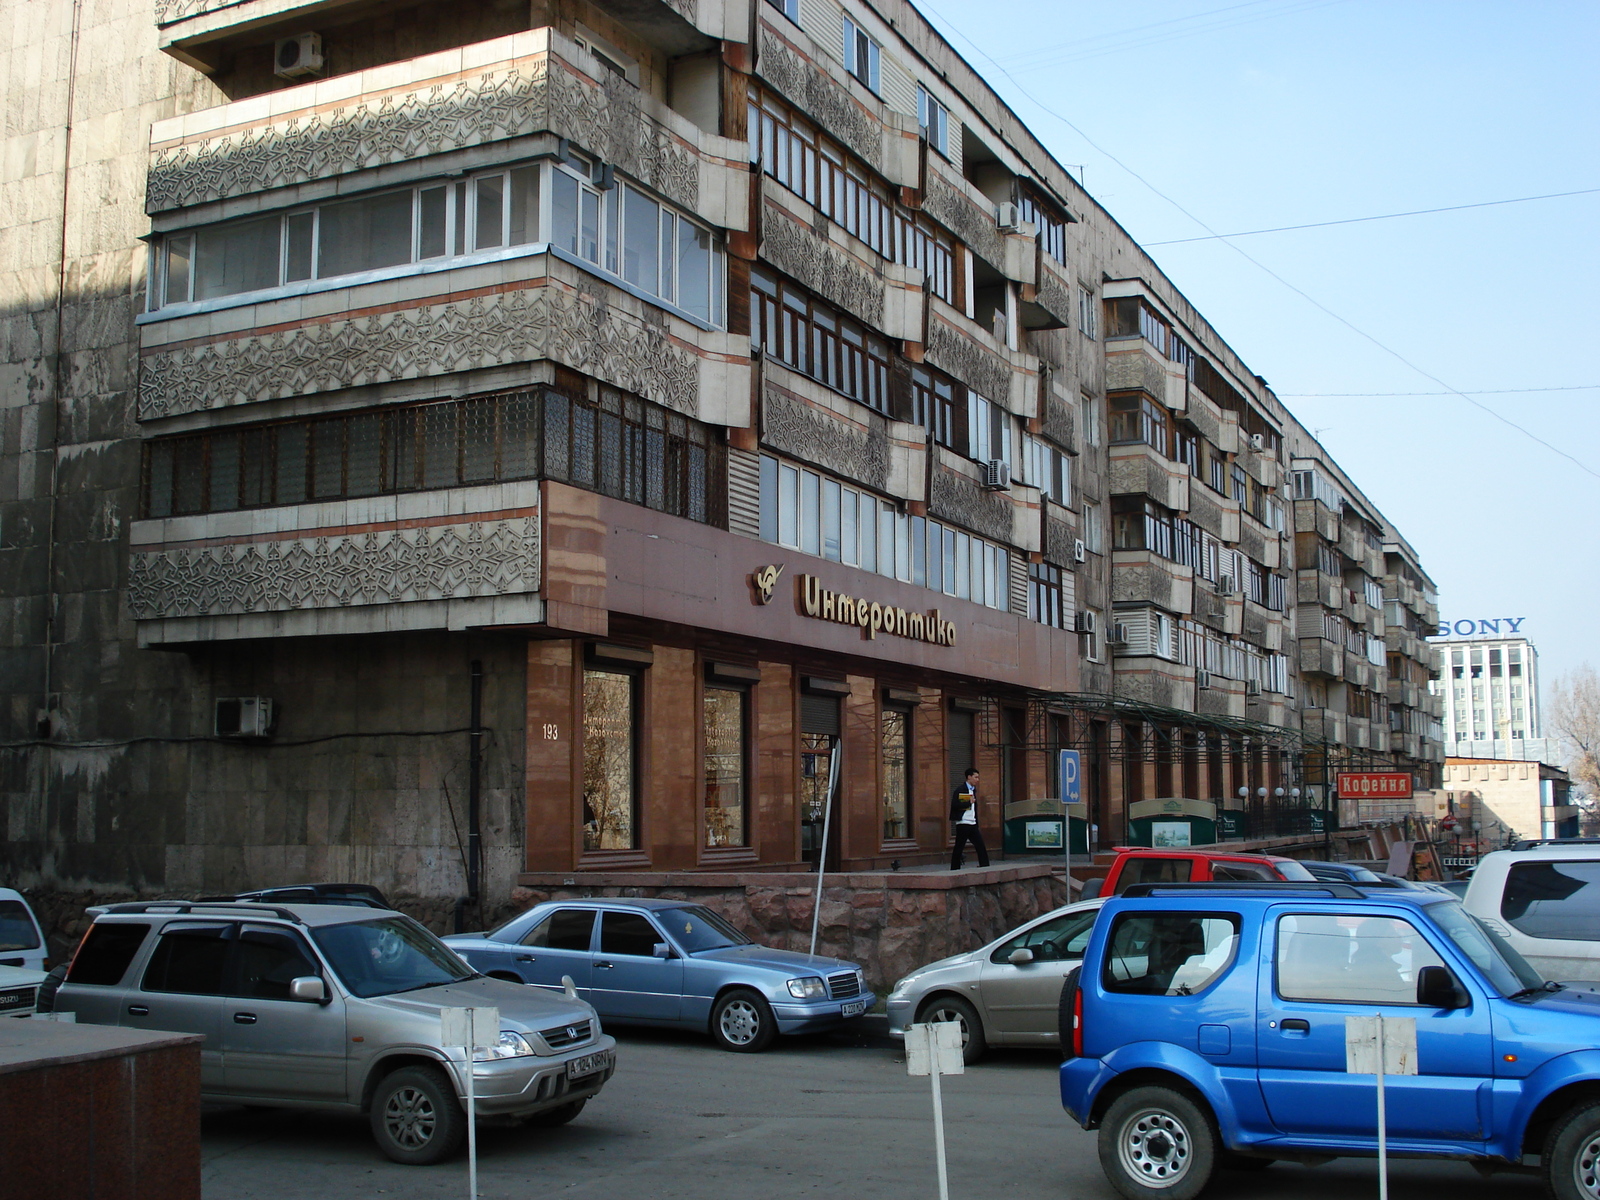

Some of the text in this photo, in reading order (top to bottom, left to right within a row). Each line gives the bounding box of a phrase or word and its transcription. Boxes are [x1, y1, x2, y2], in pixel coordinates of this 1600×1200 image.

[800, 573, 957, 647] Интероптика
[1438, 617, 1526, 637] SONY
[542, 723, 559, 741] 193
[1066, 757, 1077, 797] P
[1343, 776, 1406, 795] Кофейня
